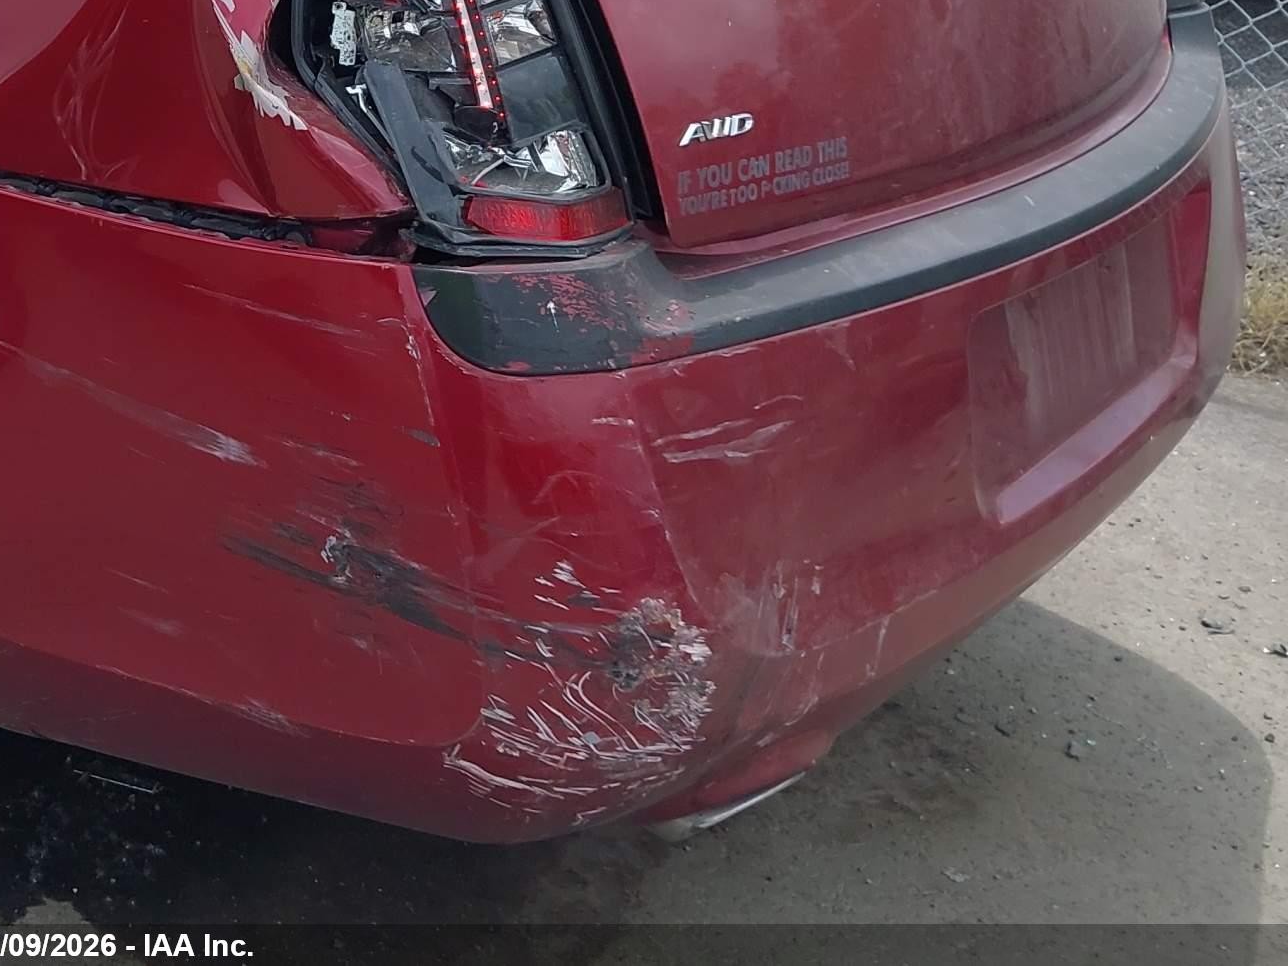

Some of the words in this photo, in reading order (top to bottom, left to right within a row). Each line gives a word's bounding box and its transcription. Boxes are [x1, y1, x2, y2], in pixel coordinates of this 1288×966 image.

[678, 113, 754, 147] AWD
[678, 170, 691, 195] IF
[697, 162, 732, 189] YOU
[738, 154, 770, 181] CAN
[776, 146, 811, 172] READ
[817, 137, 847, 163] THIS
[729, 185, 757, 206] TOO
